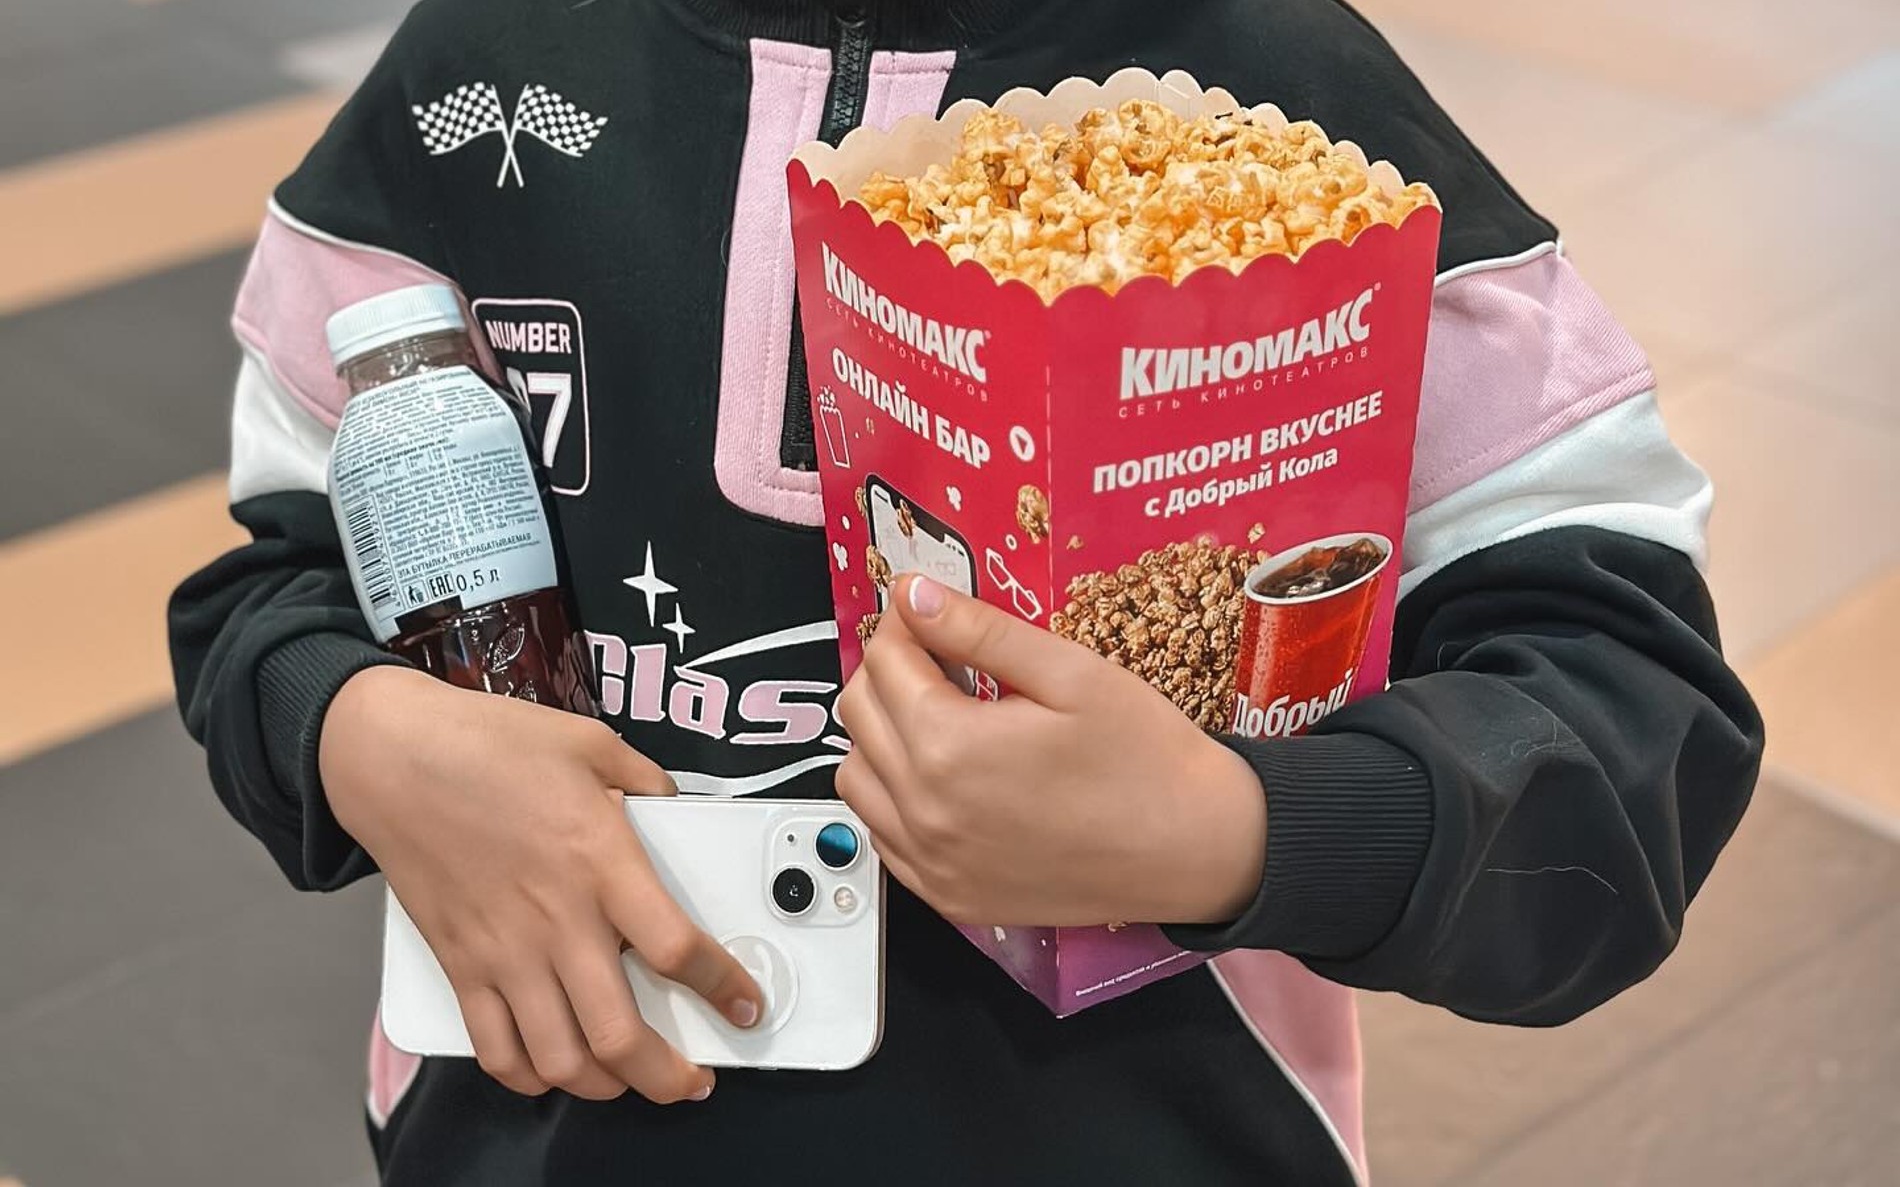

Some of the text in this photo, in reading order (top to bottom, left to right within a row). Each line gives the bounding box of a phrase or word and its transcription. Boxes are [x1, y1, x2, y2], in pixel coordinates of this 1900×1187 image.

[485, 320, 572, 354] NUMBER
[821, 241, 987, 384] КИНОМАКС
[826, 297, 988, 402] СЕТЬ КИНОТЕАТРОВ
[1120, 288, 1373, 400] КИНОМАКС
[832, 347, 991, 469] ОНЛАЙН БАР
[1118, 347, 1369, 418] СЕТЬ КИНОТЕАТРОВ
[1093, 390, 1383, 494] ПОПКОРН ВКУСНЕЕ
[1144, 447, 1338, 518] с Добрый Кола
[456, 568, 500, 592] 0,5 л
[1232, 667, 1353, 738] Добрый
